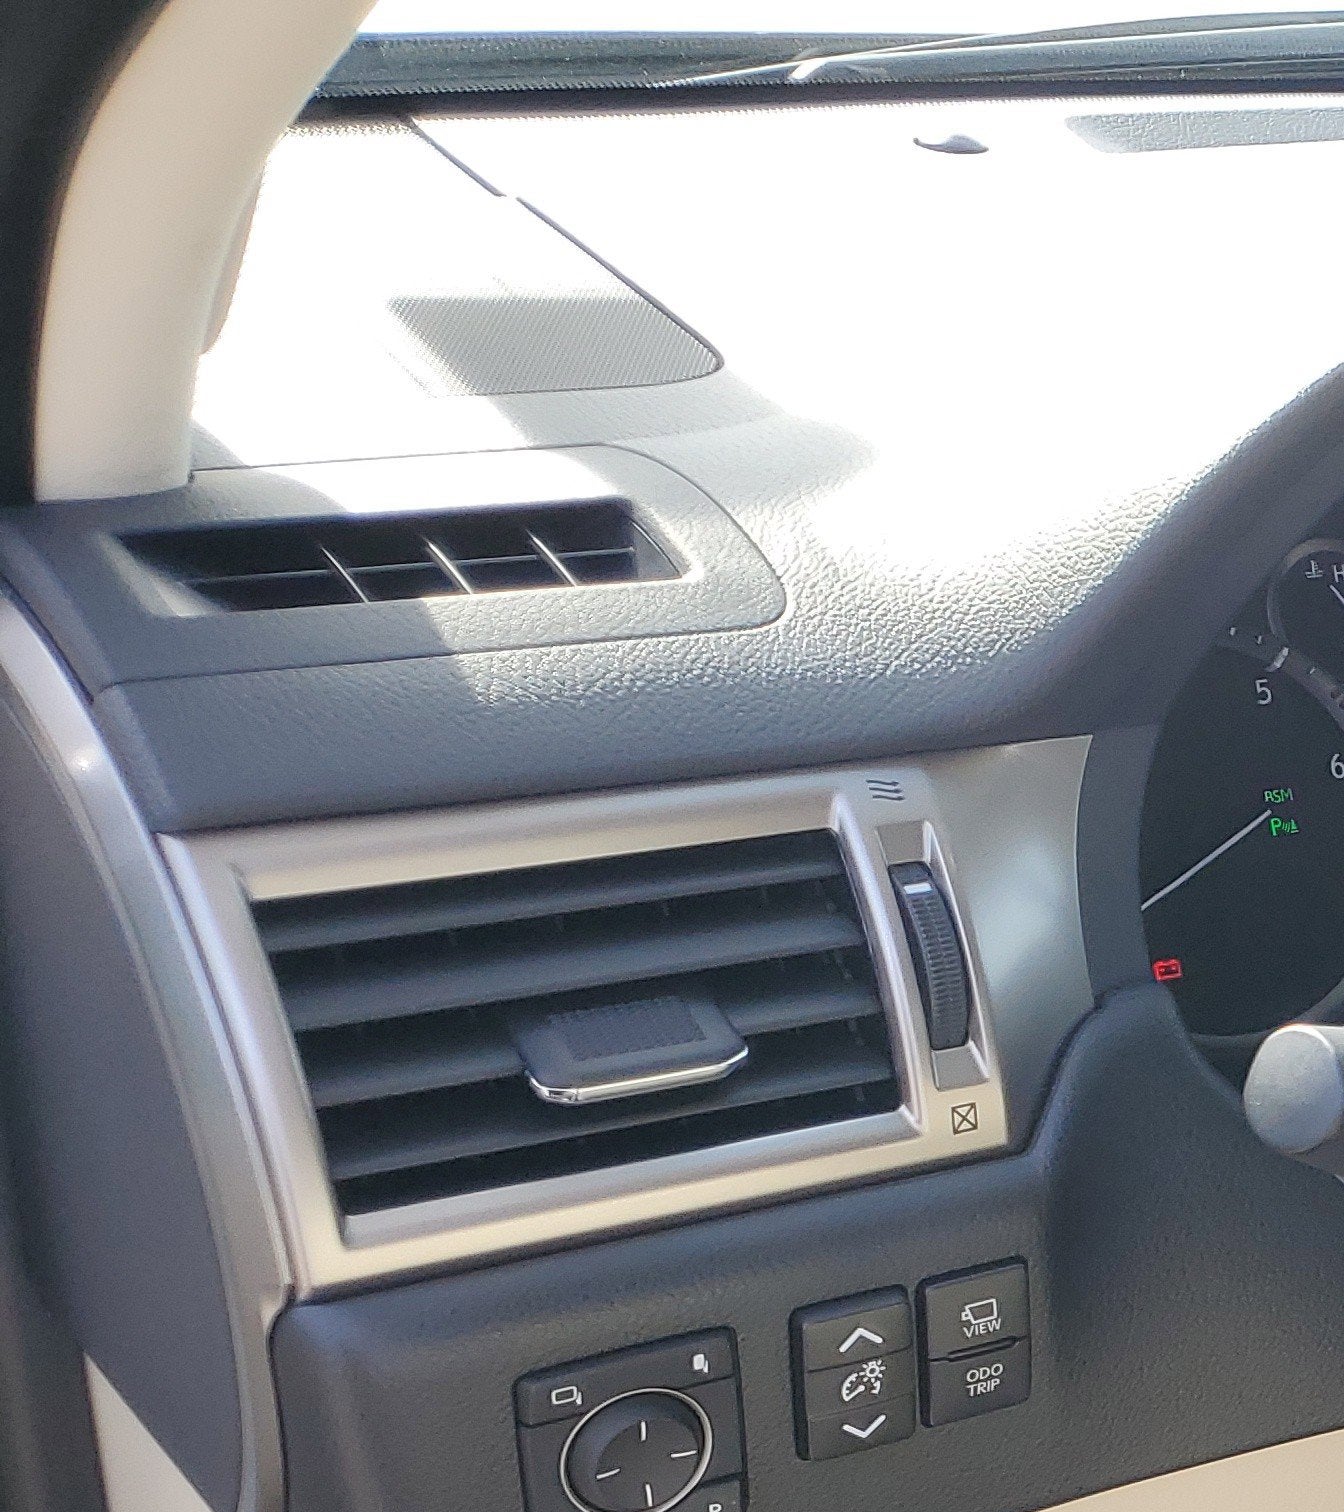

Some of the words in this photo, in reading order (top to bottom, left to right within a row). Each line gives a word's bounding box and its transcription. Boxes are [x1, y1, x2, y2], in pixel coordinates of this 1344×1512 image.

[1254, 678, 1273, 705] 5
[963, 1318, 1002, 1338] VIEW
[966, 1363, 1004, 1383] ODO
[966, 1378, 1001, 1397] TRIP
